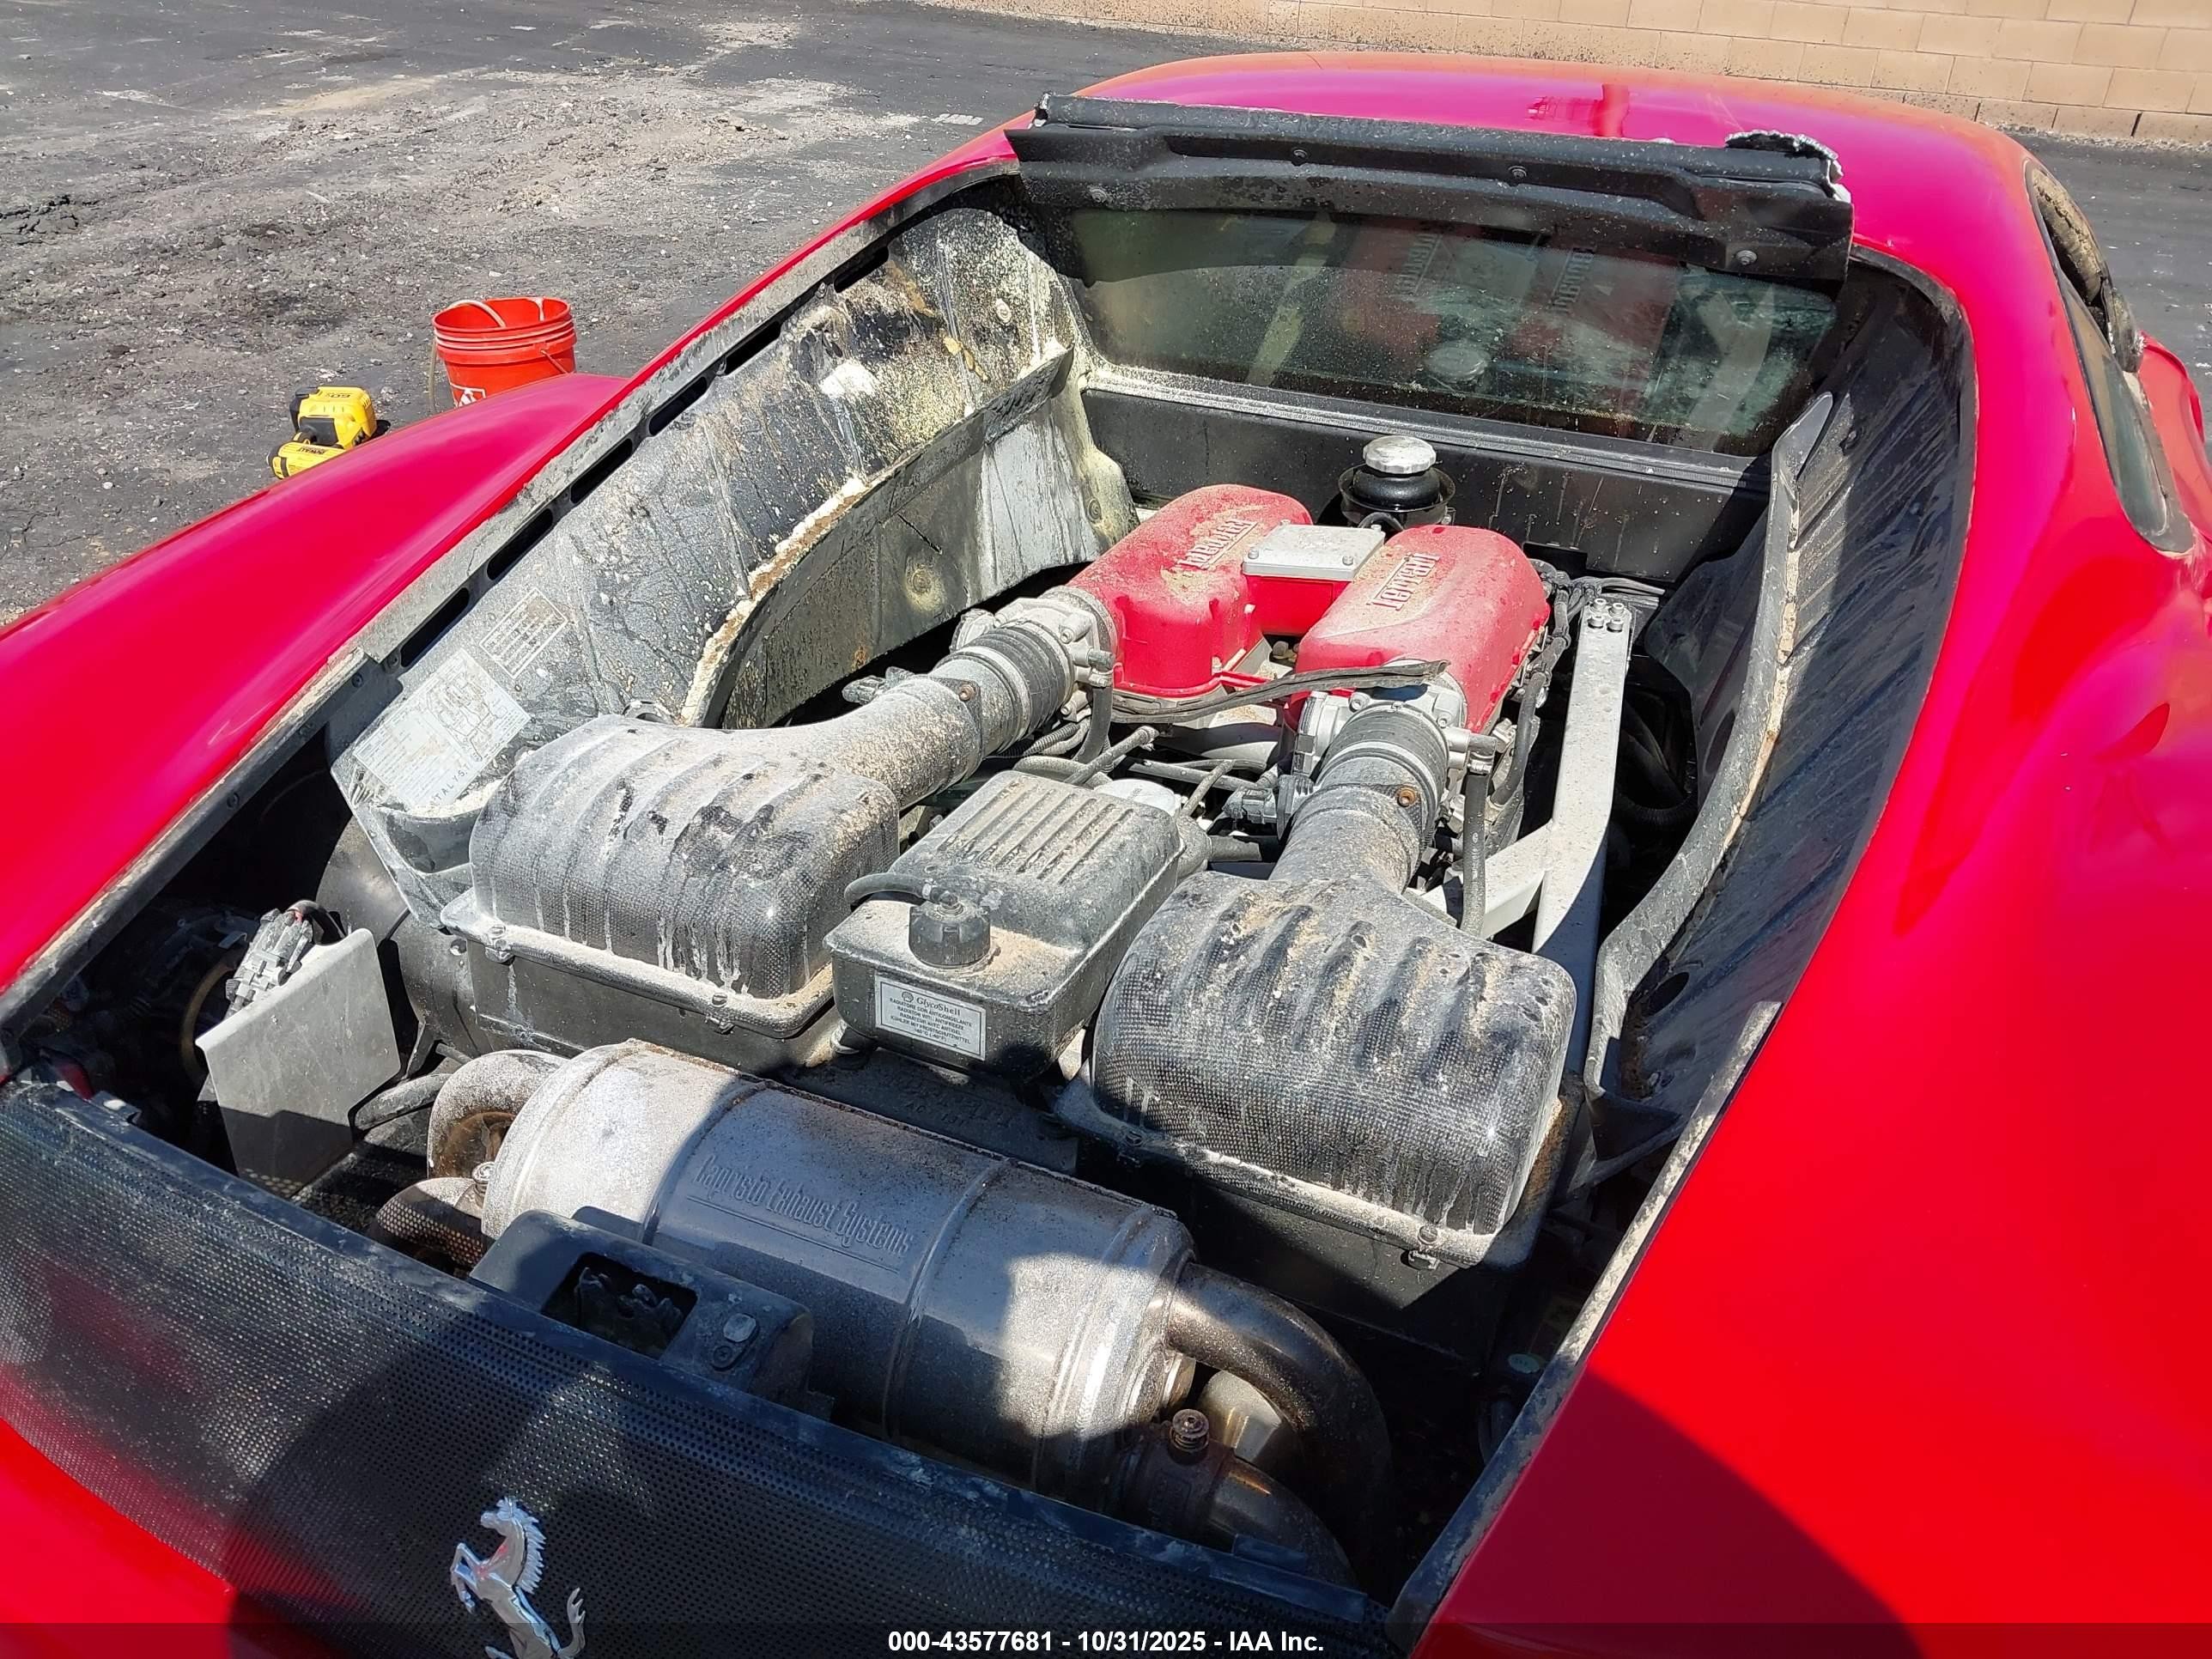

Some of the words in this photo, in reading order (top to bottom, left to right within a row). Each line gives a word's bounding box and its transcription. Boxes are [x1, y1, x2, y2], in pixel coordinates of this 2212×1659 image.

[1371, 552, 1442, 611] Ferrari
[889, 998, 916, 1009] RADIATORE
[916, 996, 961, 1016] GlycoShell
[897, 1006, 921, 1018] RADIATOR
[935, 1018, 964, 1030] ANTIFREEZE
[899, 1012, 927, 1024] RADIATEUR
[694, 1154, 771, 1206] Capristo
[766, 1179, 842, 1231] Exhaust
[836, 1202, 915, 1255] Systems
